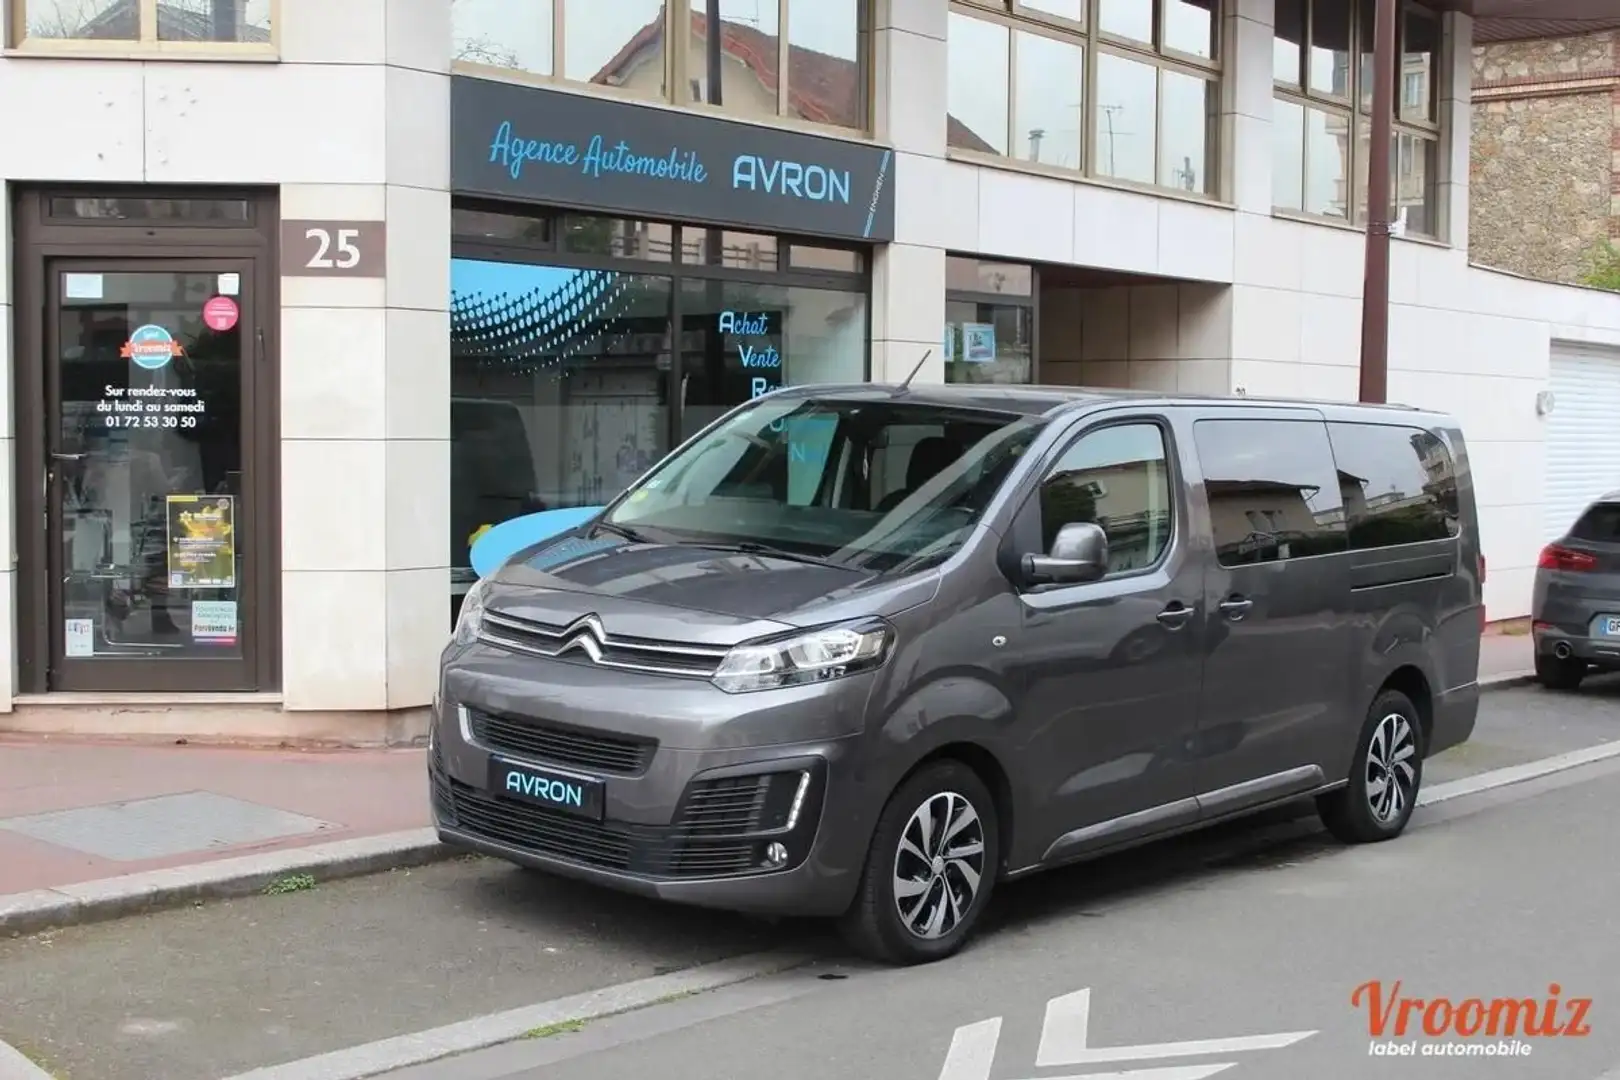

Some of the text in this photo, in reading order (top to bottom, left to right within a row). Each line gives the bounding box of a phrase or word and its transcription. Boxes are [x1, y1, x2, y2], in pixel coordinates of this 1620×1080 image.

[489, 120, 851, 205] Agence Automobile AVRON
[305, 228, 361, 268] 25
[719, 311, 769, 335] Achat
[738, 344, 782, 368] Vente
[105, 384, 197, 397] Sur rendez-vous
[97, 400, 205, 412] du lundi au samedi
[105, 416, 197, 428] 01 72 53 30 50
[506, 771, 582, 807] AVRON
